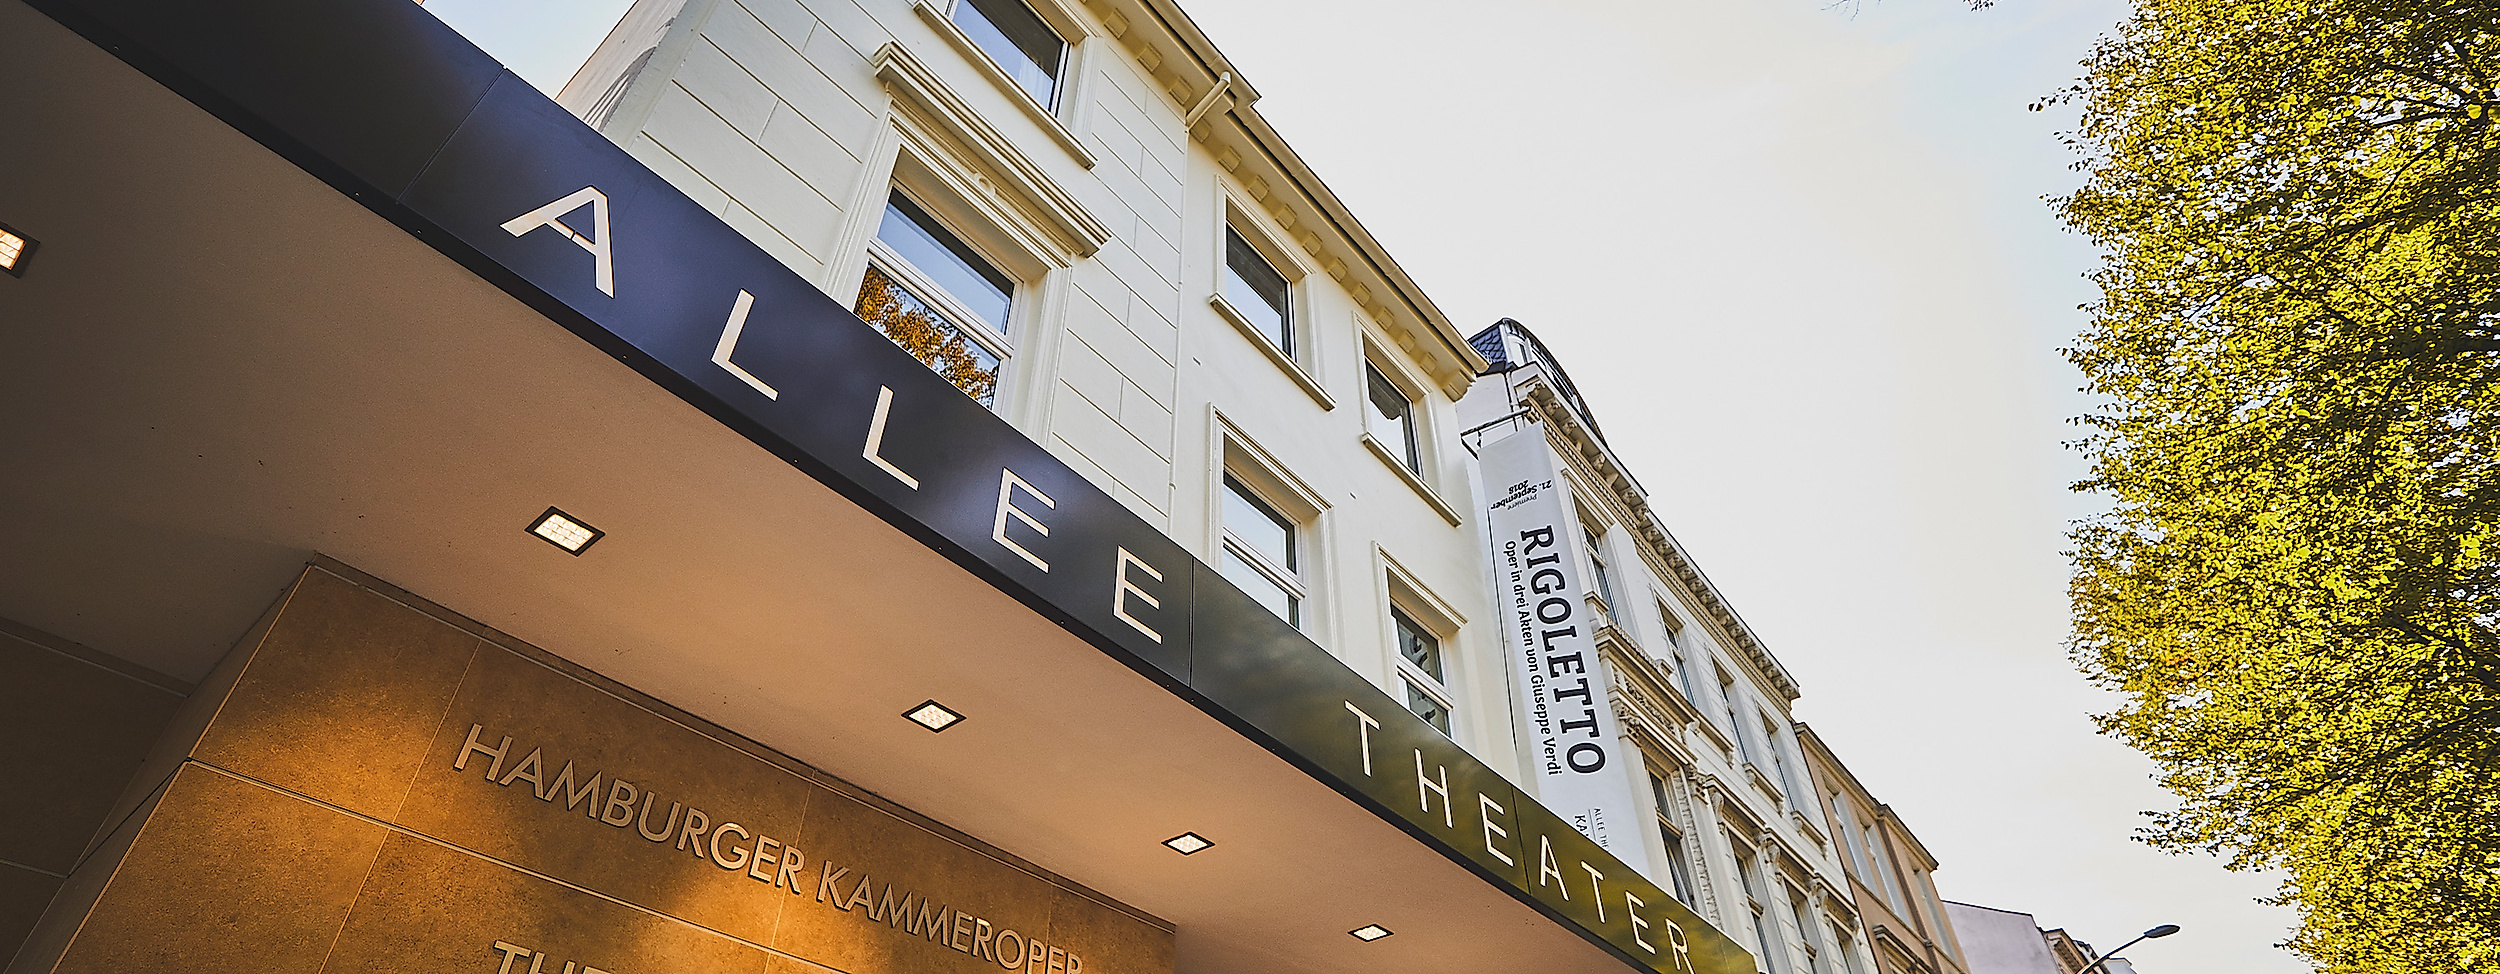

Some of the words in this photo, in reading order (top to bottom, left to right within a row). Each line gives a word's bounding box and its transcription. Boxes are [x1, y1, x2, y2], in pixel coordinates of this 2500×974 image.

[1490, 484, 1538, 510] September
[1503, 540, 1518, 569] Oper
[499, 184, 1164, 645] ALLEE
[1344, 699, 1696, 974] THEATER
[1510, 570, 1523, 583] in
[1513, 584, 1530, 609] drei
[1518, 610, 1534, 647] Akten
[1520, 524, 1606, 774] RIGOLETTO
[1525, 648, 1539, 673] von
[1530, 674, 1551, 735] Giuseppe
[1542, 736, 1563, 776] Verdi
[453, 722, 806, 896] HAMBURGER
[1593, 807, 1606, 831] ALLEE
[1574, 814, 1590, 837] KA
